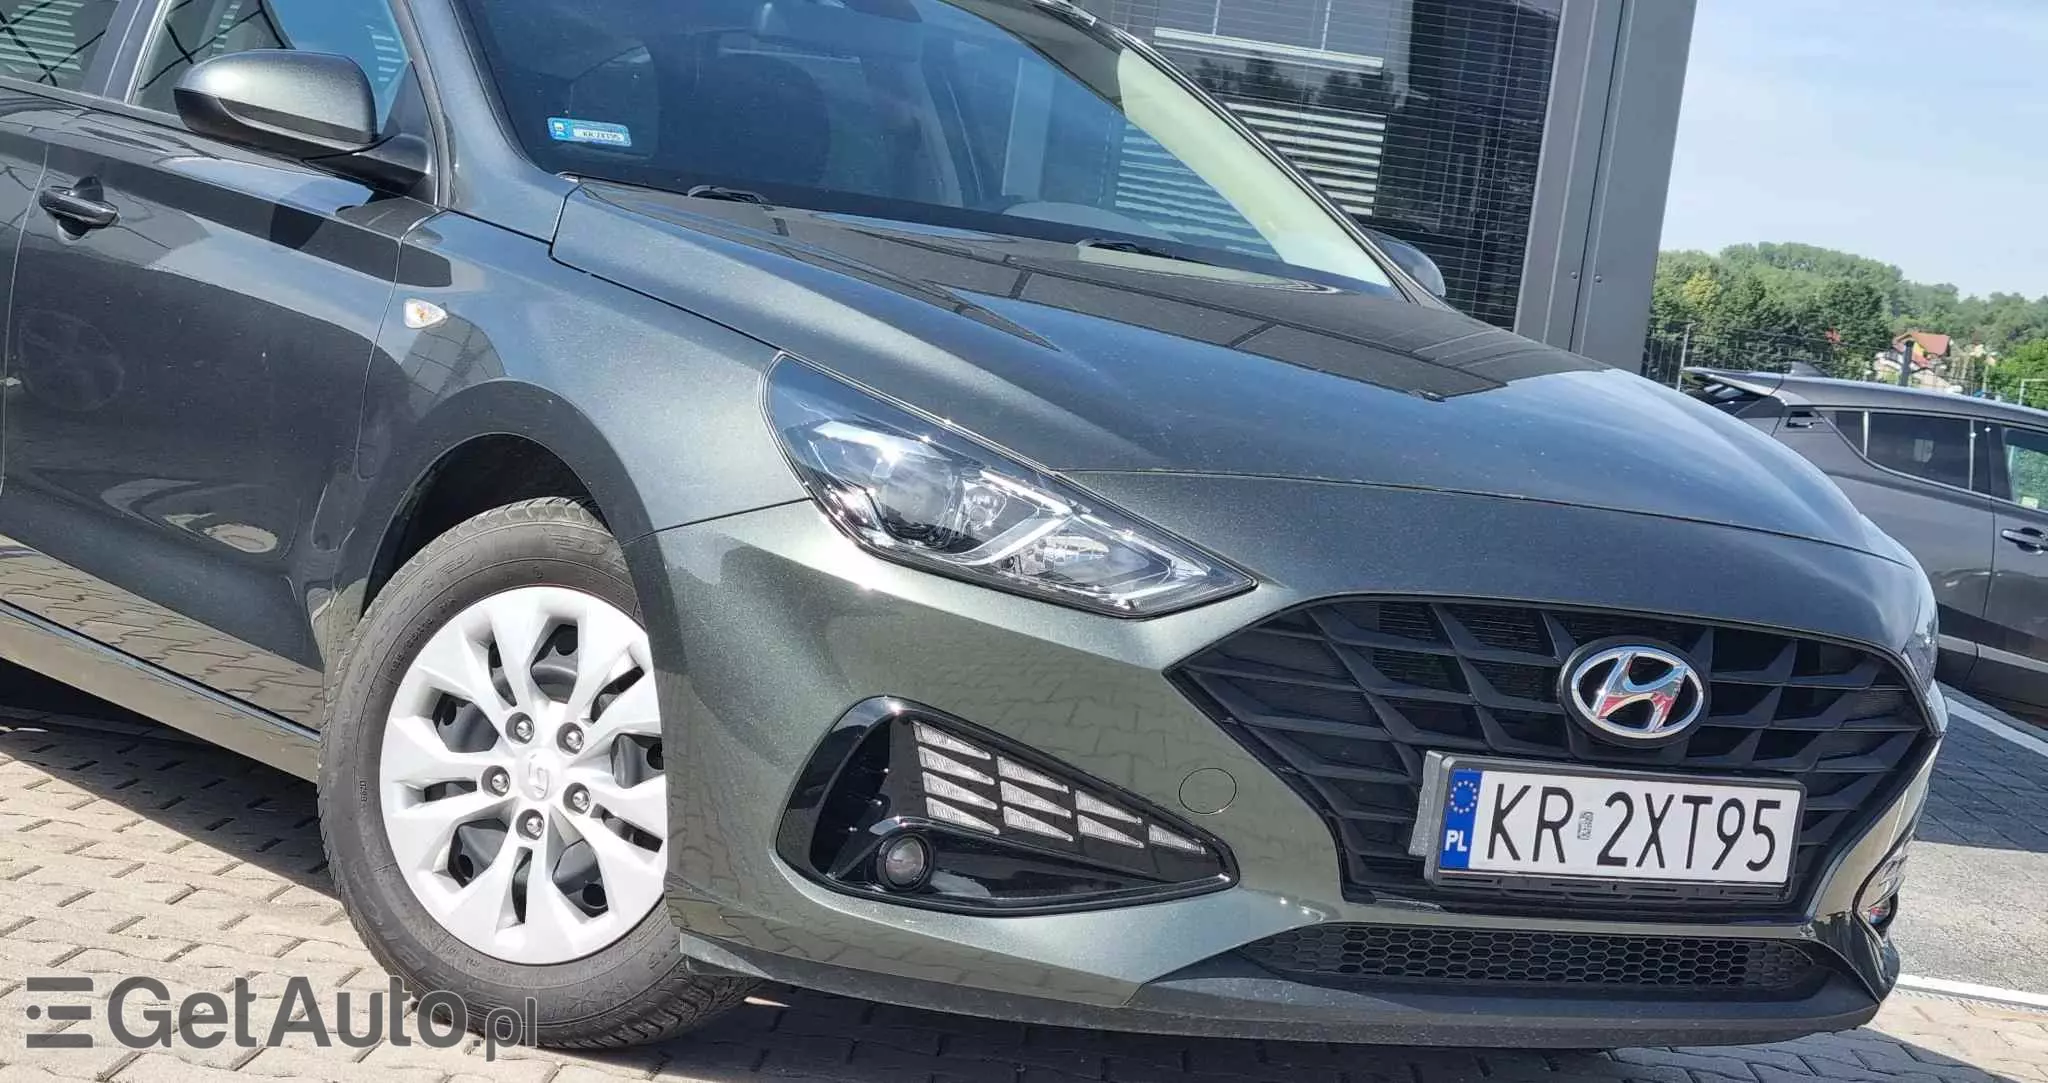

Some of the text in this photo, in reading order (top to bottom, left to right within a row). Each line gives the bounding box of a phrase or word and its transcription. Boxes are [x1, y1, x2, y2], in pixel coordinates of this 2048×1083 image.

[1445, 829, 1468, 852] PL
[1487, 783, 1782, 872] KR 2XT95
